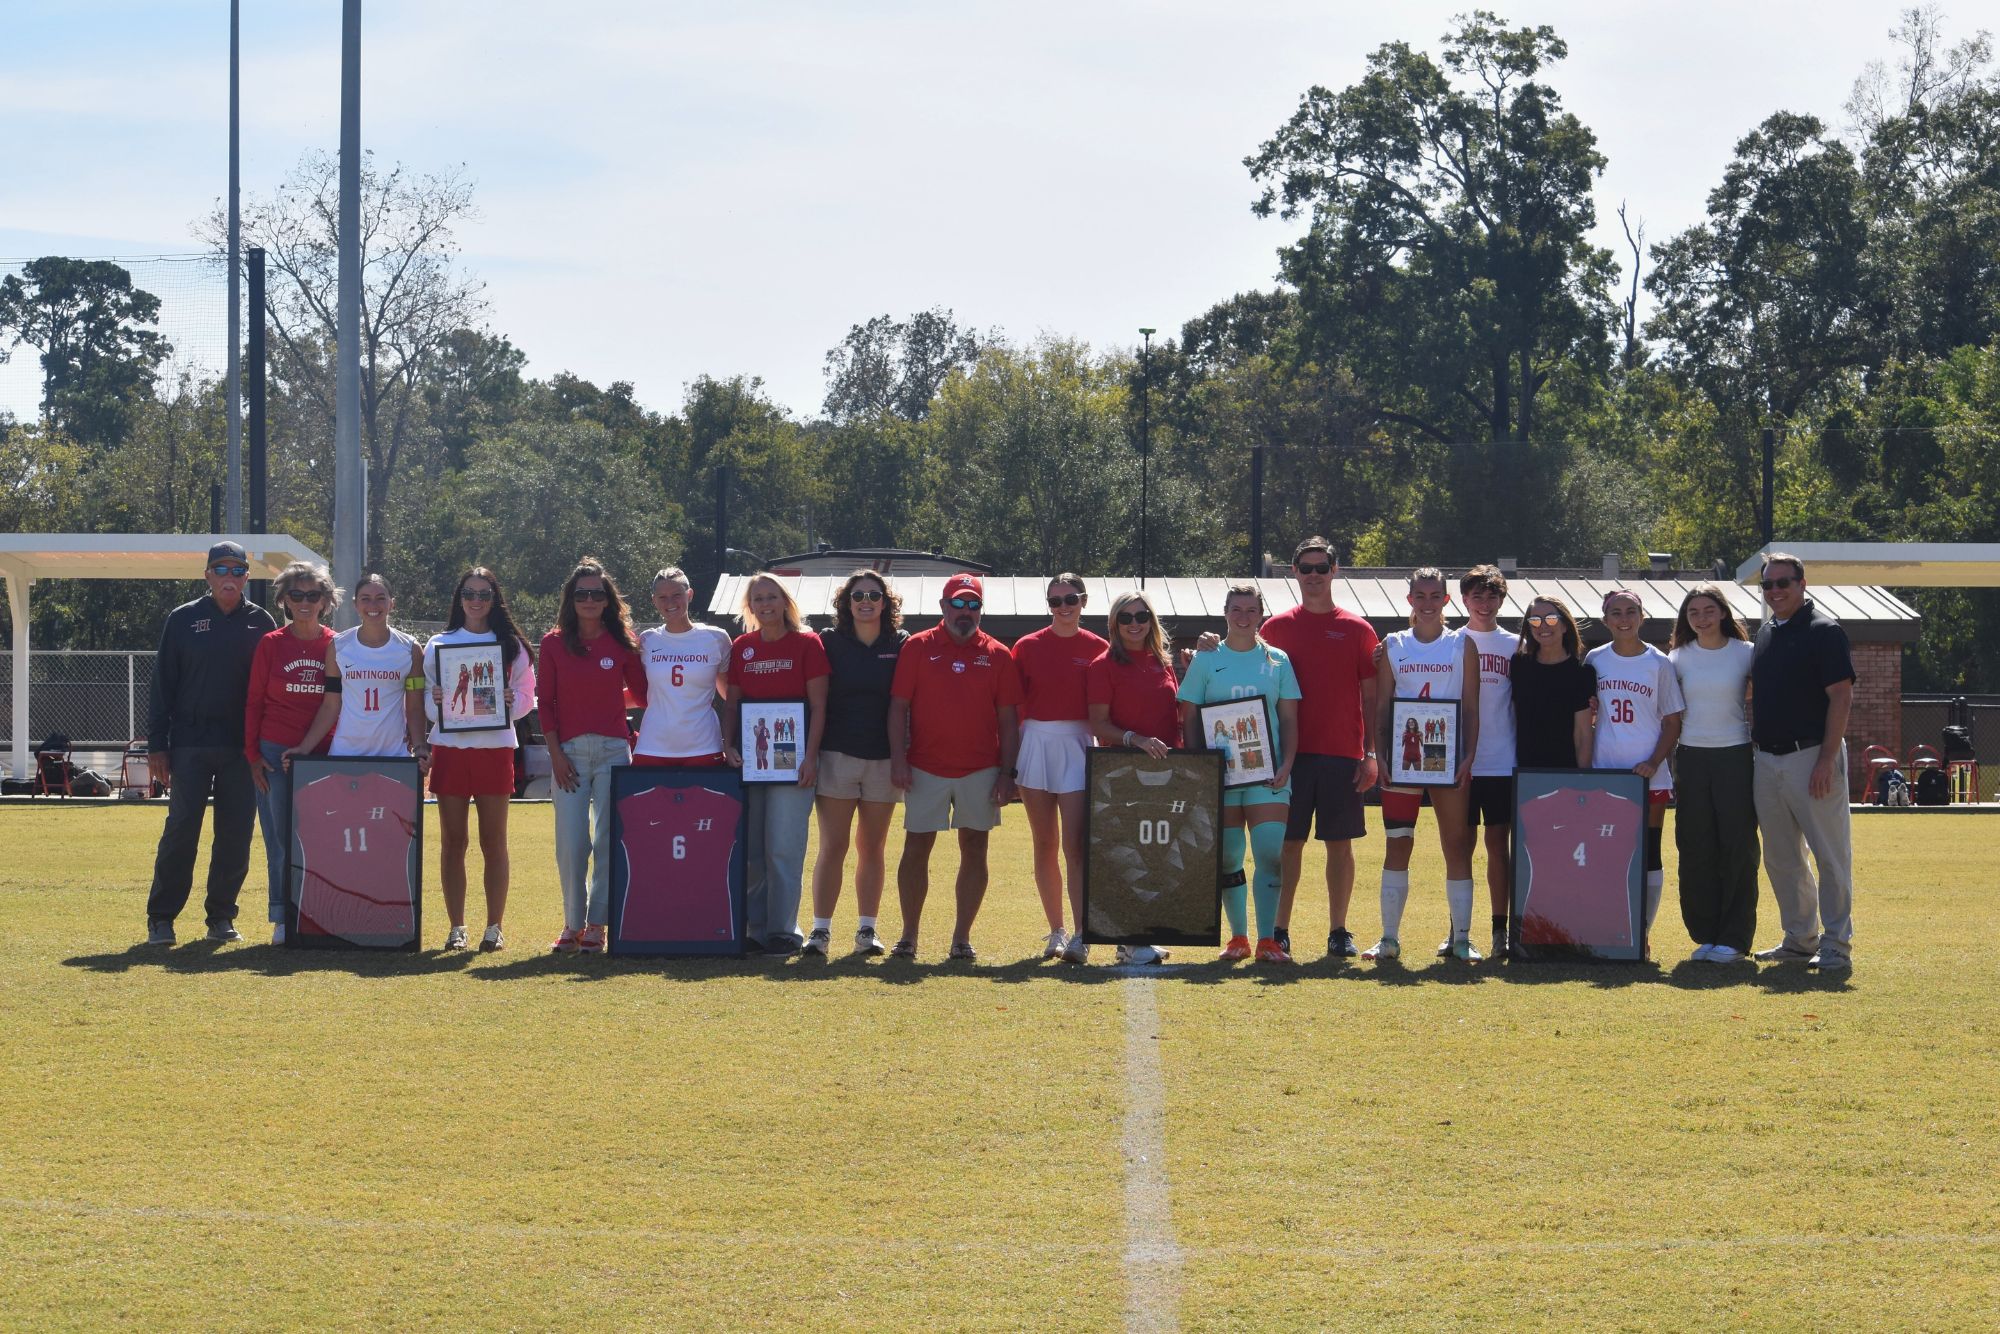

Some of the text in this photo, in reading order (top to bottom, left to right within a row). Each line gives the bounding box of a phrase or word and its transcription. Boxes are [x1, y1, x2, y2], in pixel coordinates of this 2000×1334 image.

[283, 659, 326, 672] HUNTINGDO
[651, 654, 709, 664] HUNTINGDON
[345, 670, 401, 680] HUNTINGDON
[671, 664, 684, 687] 6
[1399, 663, 1454, 674] HUNTINGDON
[1419, 682, 1432, 700] 4
[364, 687, 380, 711] 11
[1610, 699, 1634, 723] 36
[368, 806, 385, 819] H
[1169, 800, 1186, 813] H
[695, 818, 712, 831] H
[1139, 819, 1170, 845] 00
[1597, 824, 1615, 837] H
[343, 827, 368, 852] 11
[672, 835, 686, 860] 6
[1572, 842, 1586, 867] 4
